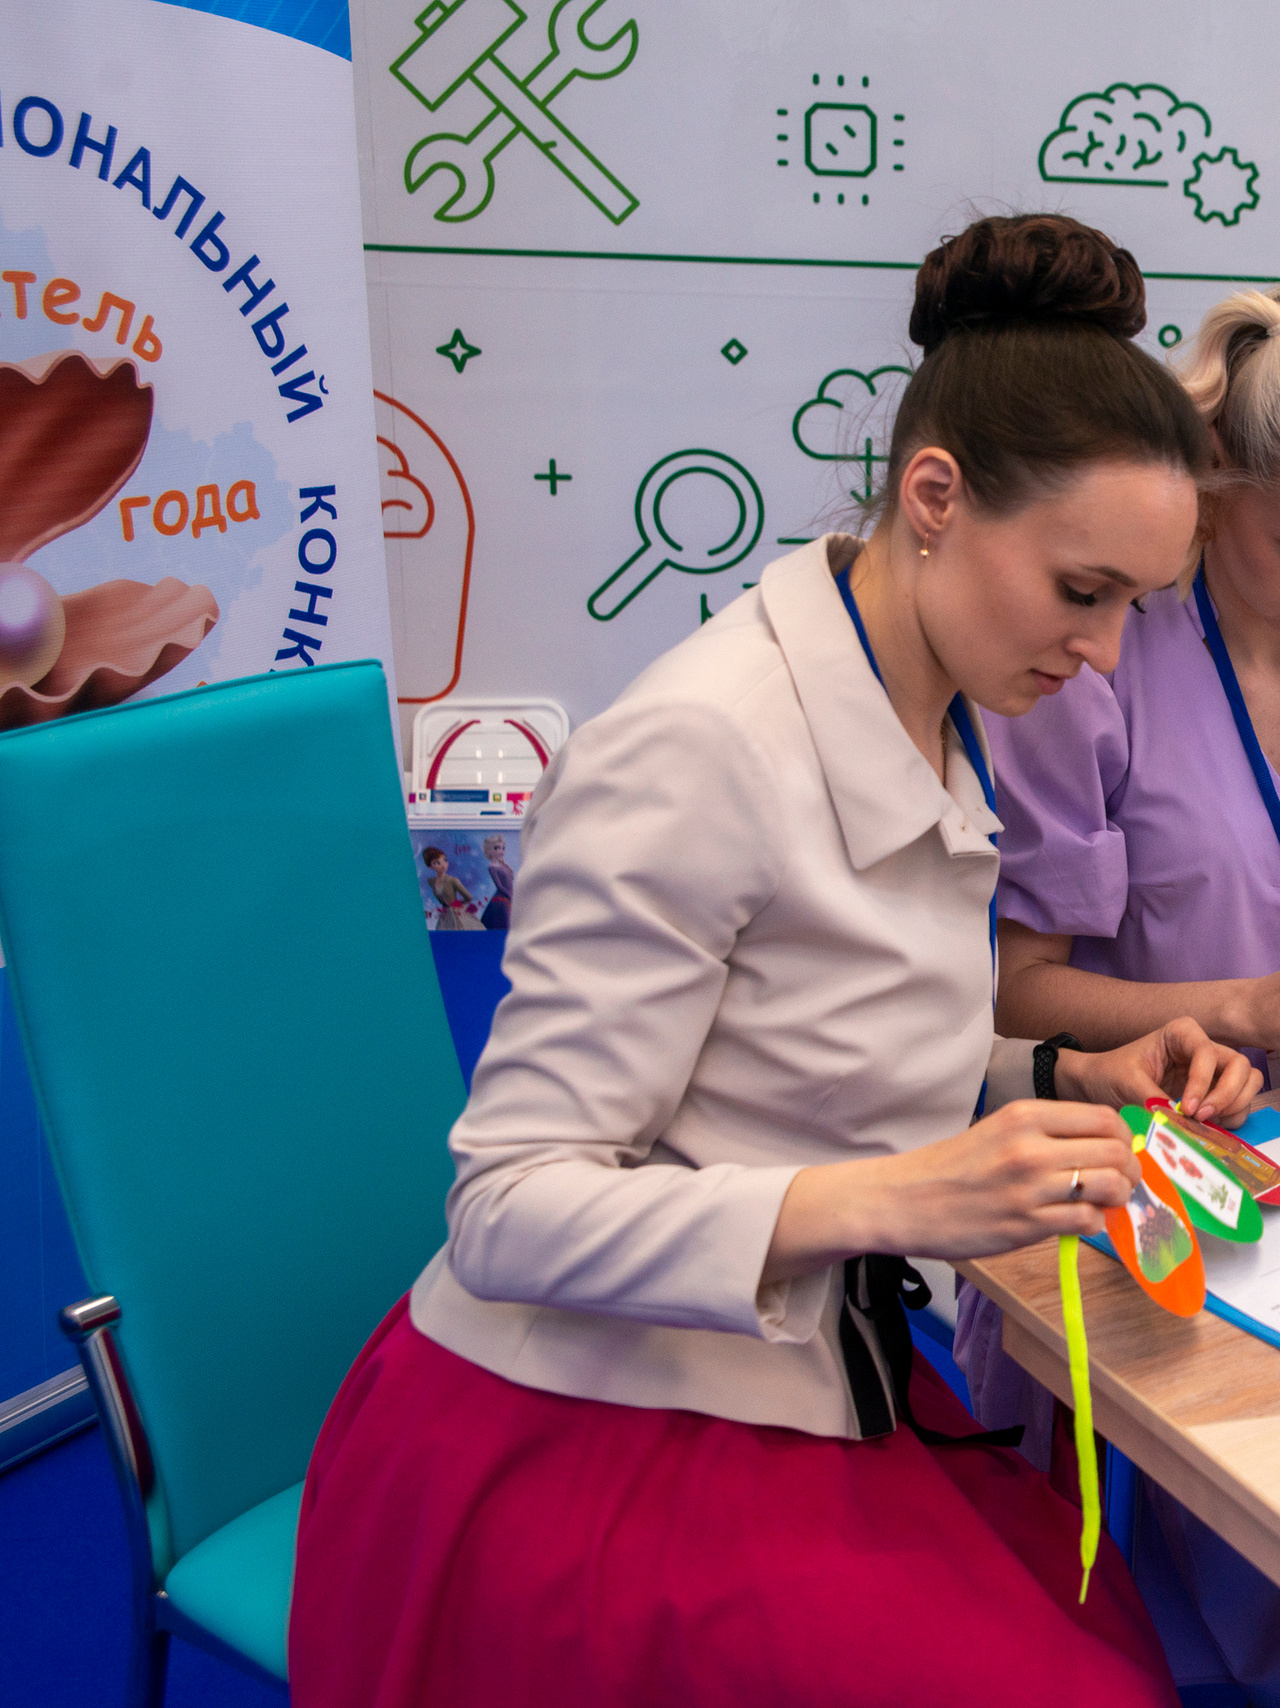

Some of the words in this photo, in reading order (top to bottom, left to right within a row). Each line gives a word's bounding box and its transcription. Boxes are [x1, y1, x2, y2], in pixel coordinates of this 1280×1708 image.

[0, 270, 164, 363] тель
[0, 96, 331, 424] ОНАЛЬНЫЙ
[270, 483, 338, 673] КОНК
[118, 479, 261, 543] года
